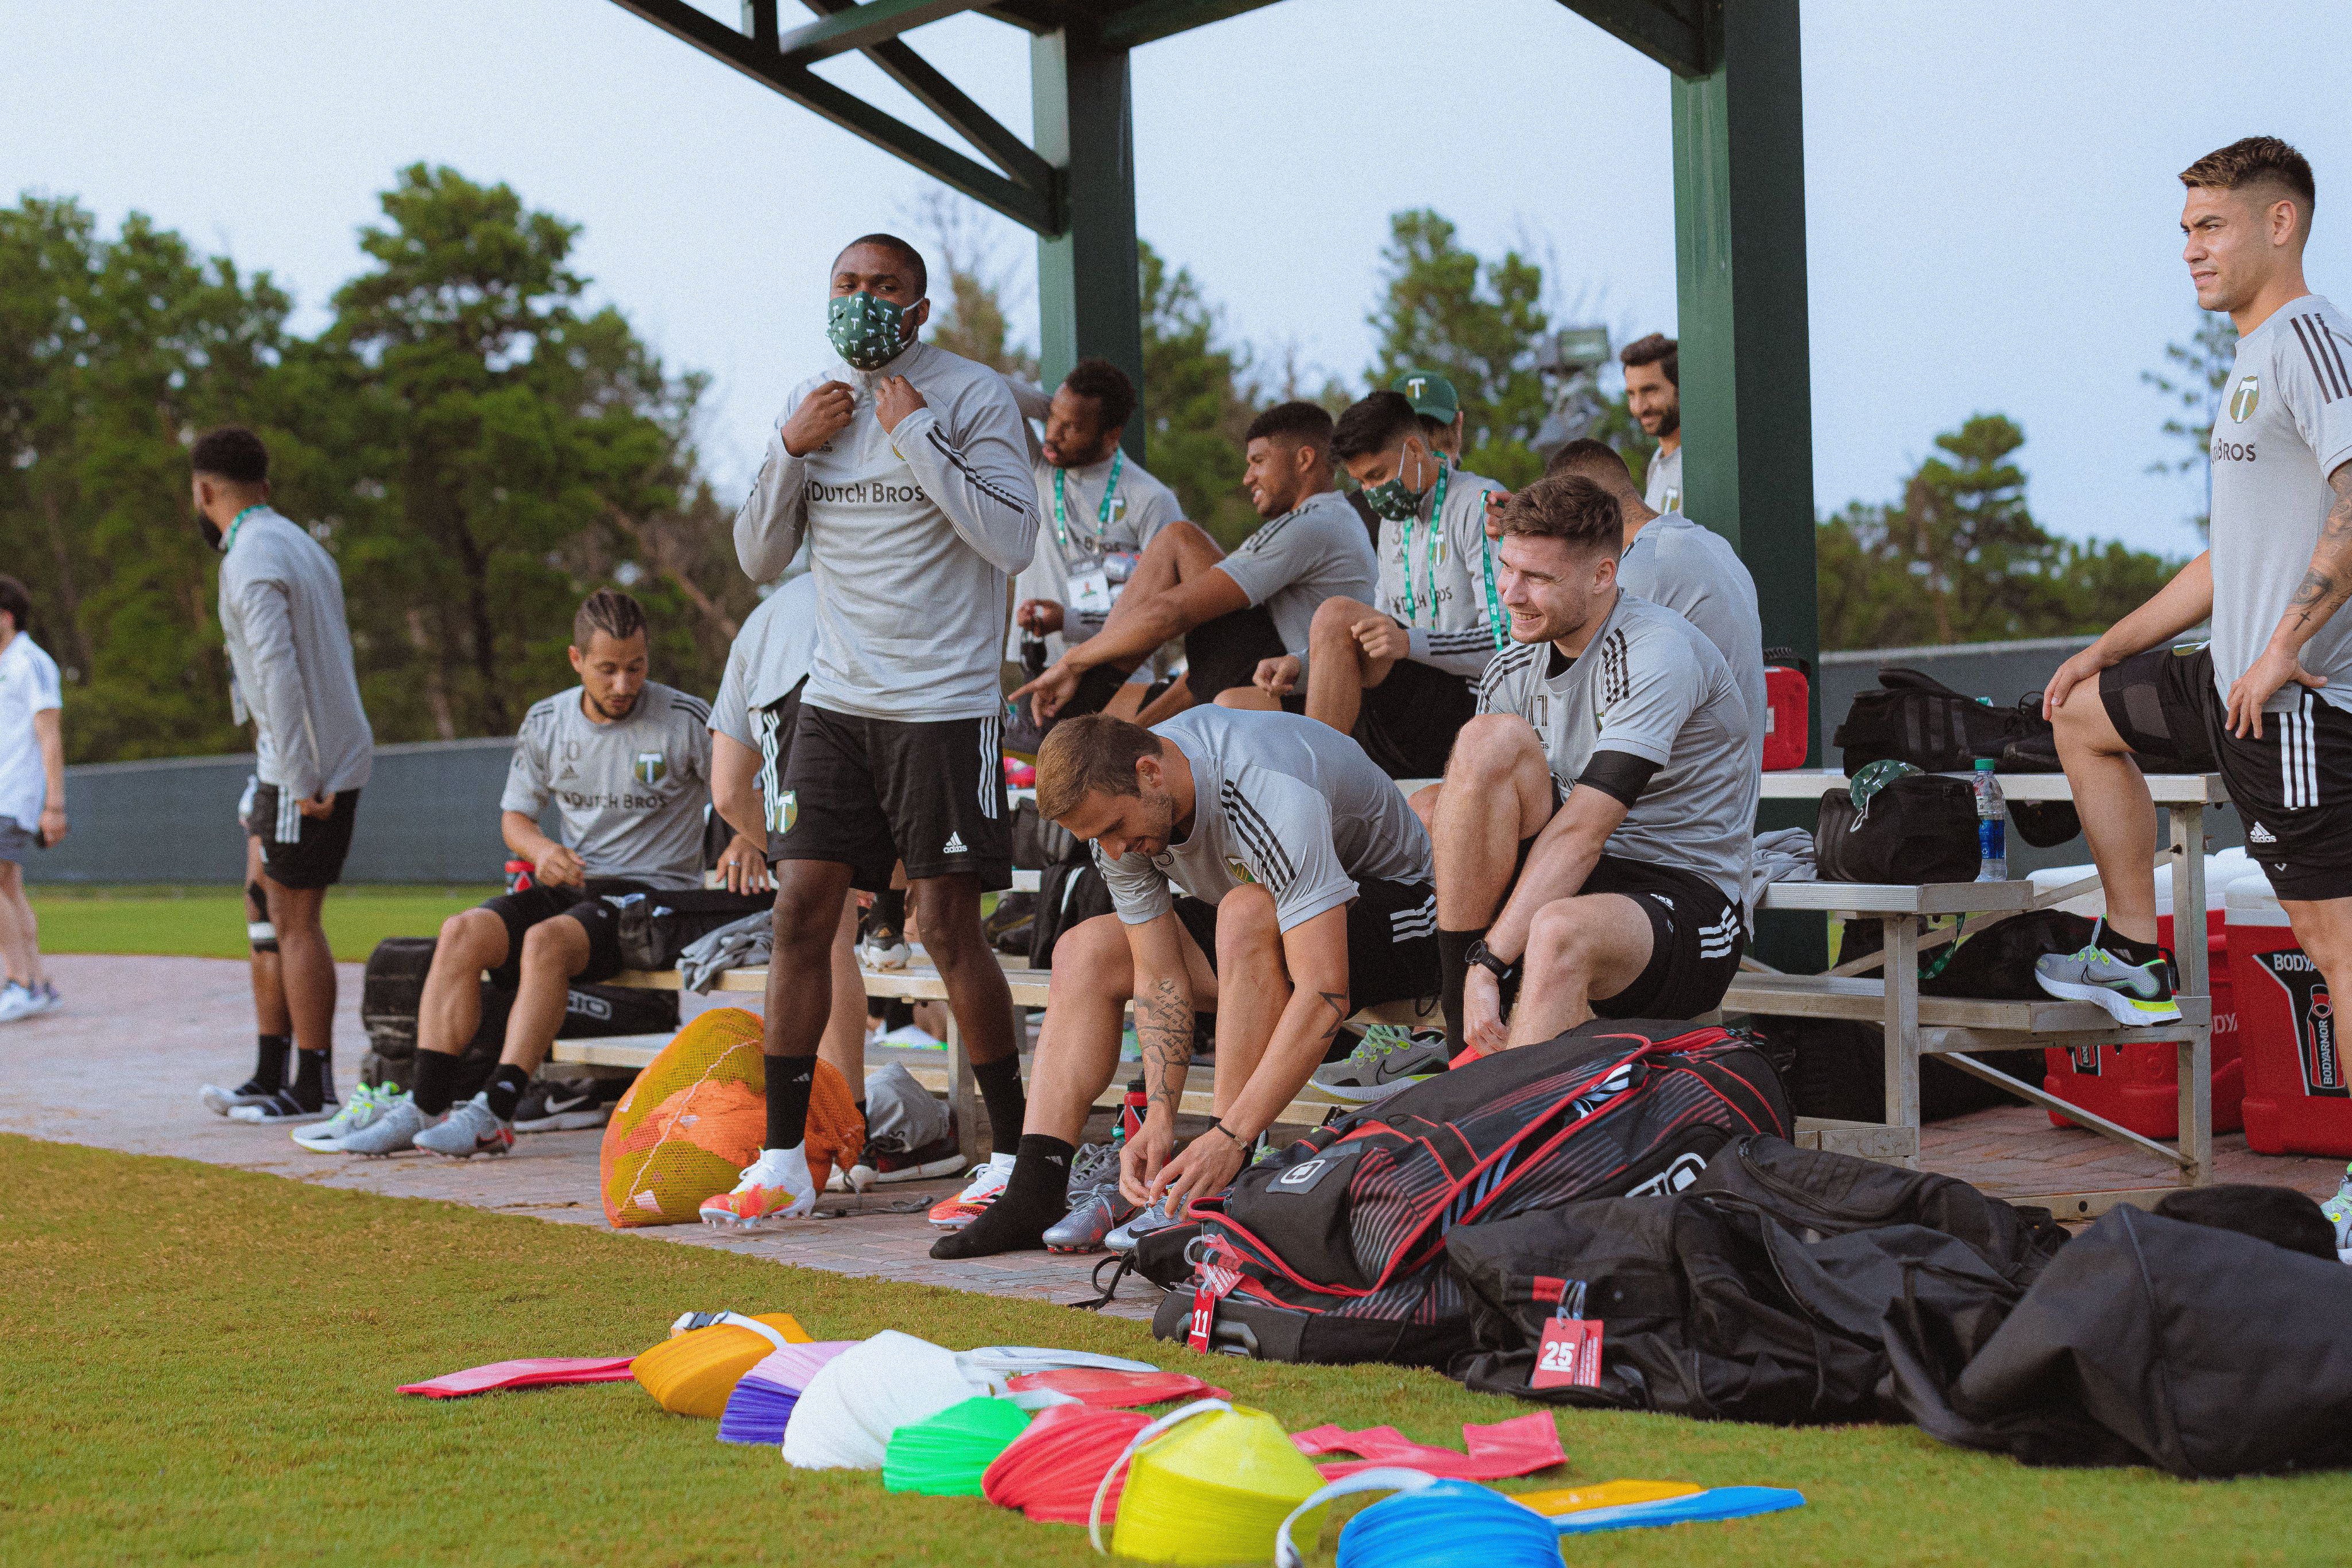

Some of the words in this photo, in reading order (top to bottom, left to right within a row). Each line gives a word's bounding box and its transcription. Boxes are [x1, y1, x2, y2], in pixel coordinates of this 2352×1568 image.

[812, 481, 866, 503] DUTCH
[872, 483, 925, 503] BROS
[943, 845, 968, 854] adidas
[2319, 1020, 2333, 1085] BODYARMOR
[1540, 1341, 1576, 1368] 25
